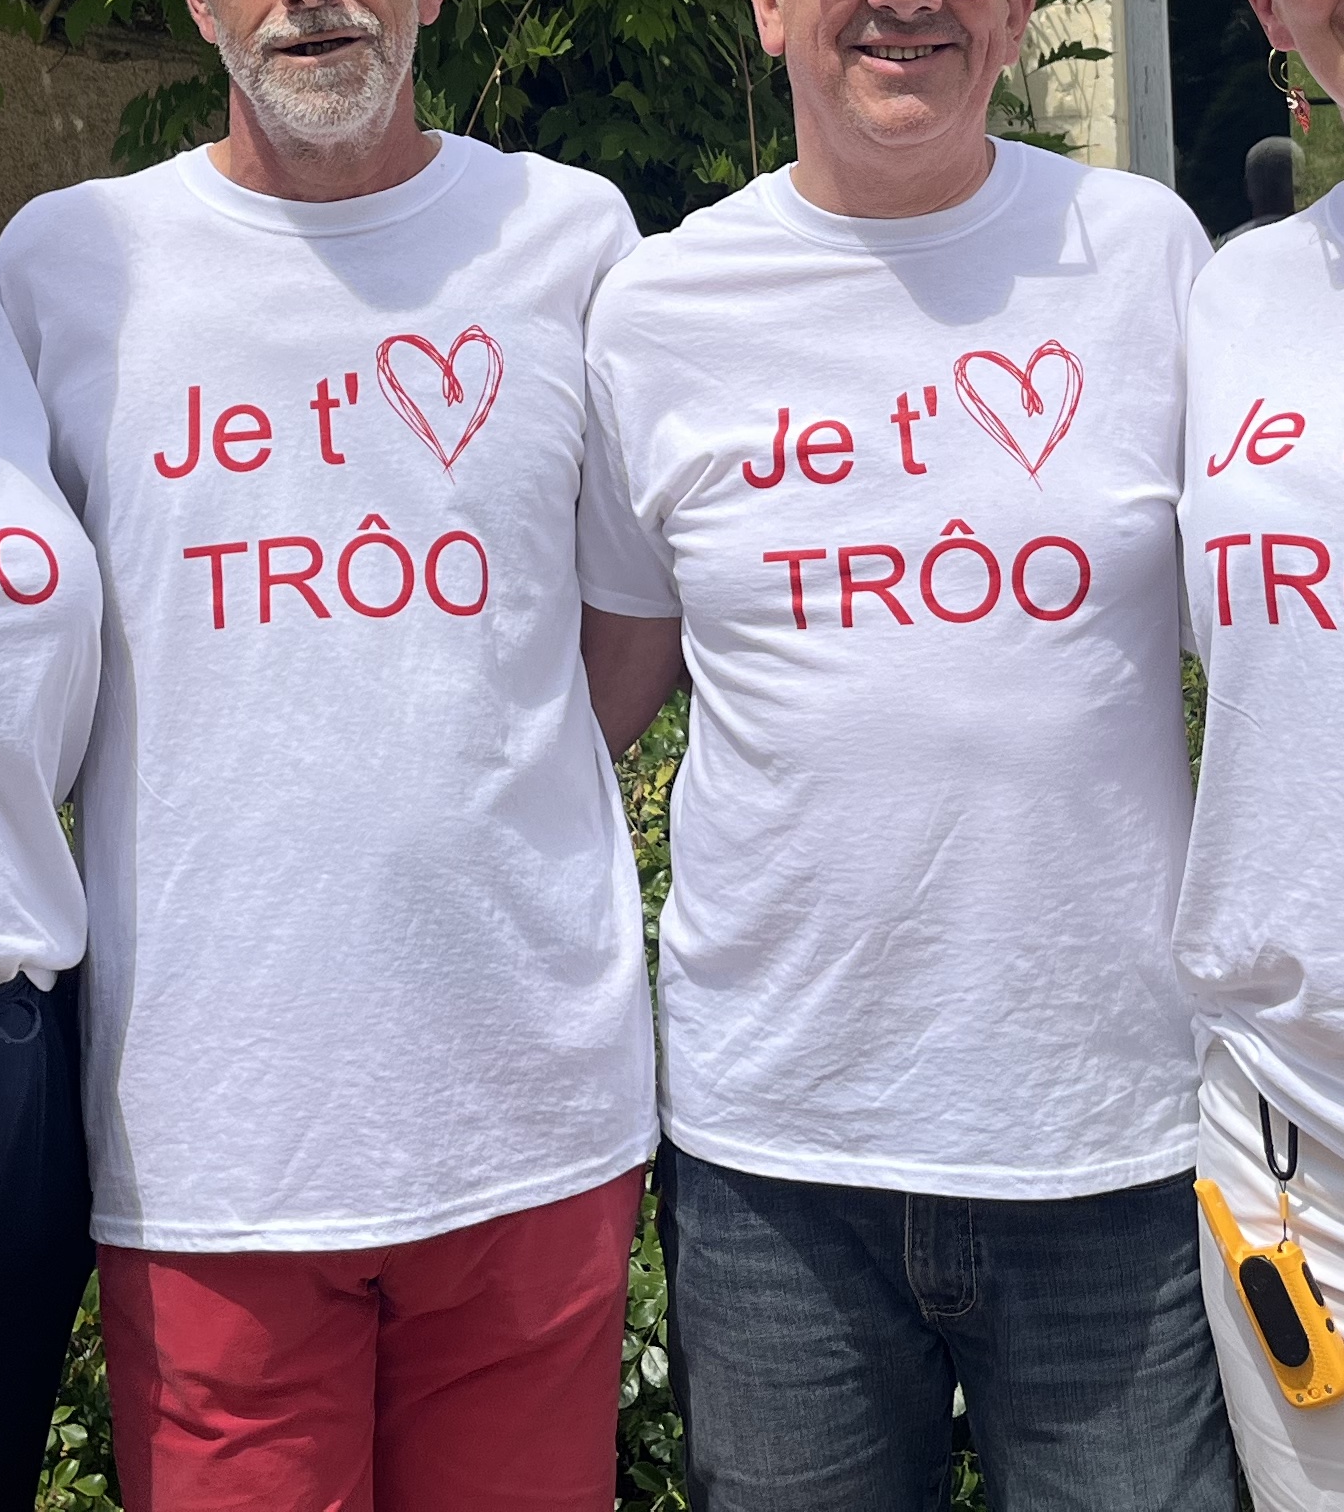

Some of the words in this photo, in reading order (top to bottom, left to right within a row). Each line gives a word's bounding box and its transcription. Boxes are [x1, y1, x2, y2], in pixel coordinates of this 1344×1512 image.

[155, 386, 272, 478] Je
[311, 373, 359, 465] t'
[743, 408, 853, 488] Je
[891, 386, 938, 476] t'
[1208, 399, 1305, 477] Je
[184, 514, 488, 629] TRÔO
[764, 519, 1090, 629] TRÔO
